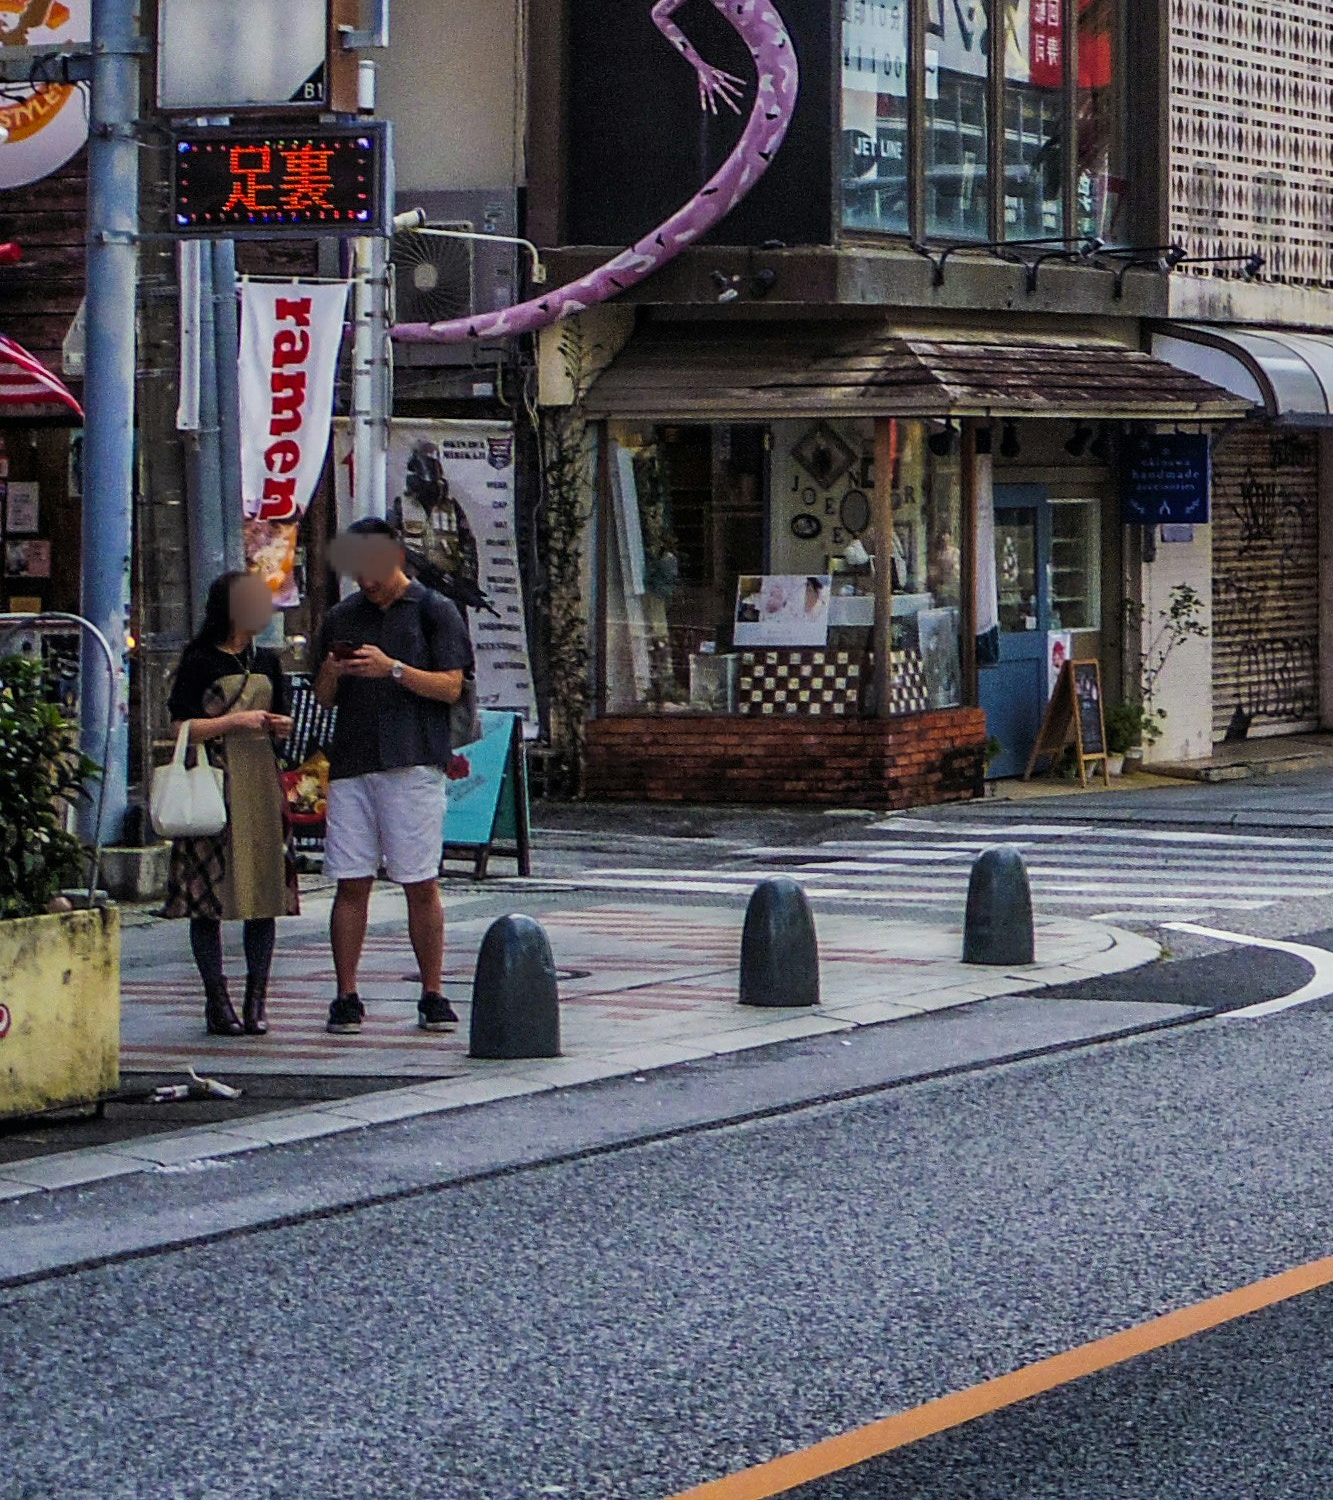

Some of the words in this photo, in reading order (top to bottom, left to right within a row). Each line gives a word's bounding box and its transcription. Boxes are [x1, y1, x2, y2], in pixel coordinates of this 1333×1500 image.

[853, 136, 878, 157] JET
[223, 145, 335, 213] 足裏
[259, 296, 313, 522] ramen
[1131, 469, 1200, 480] handmade
